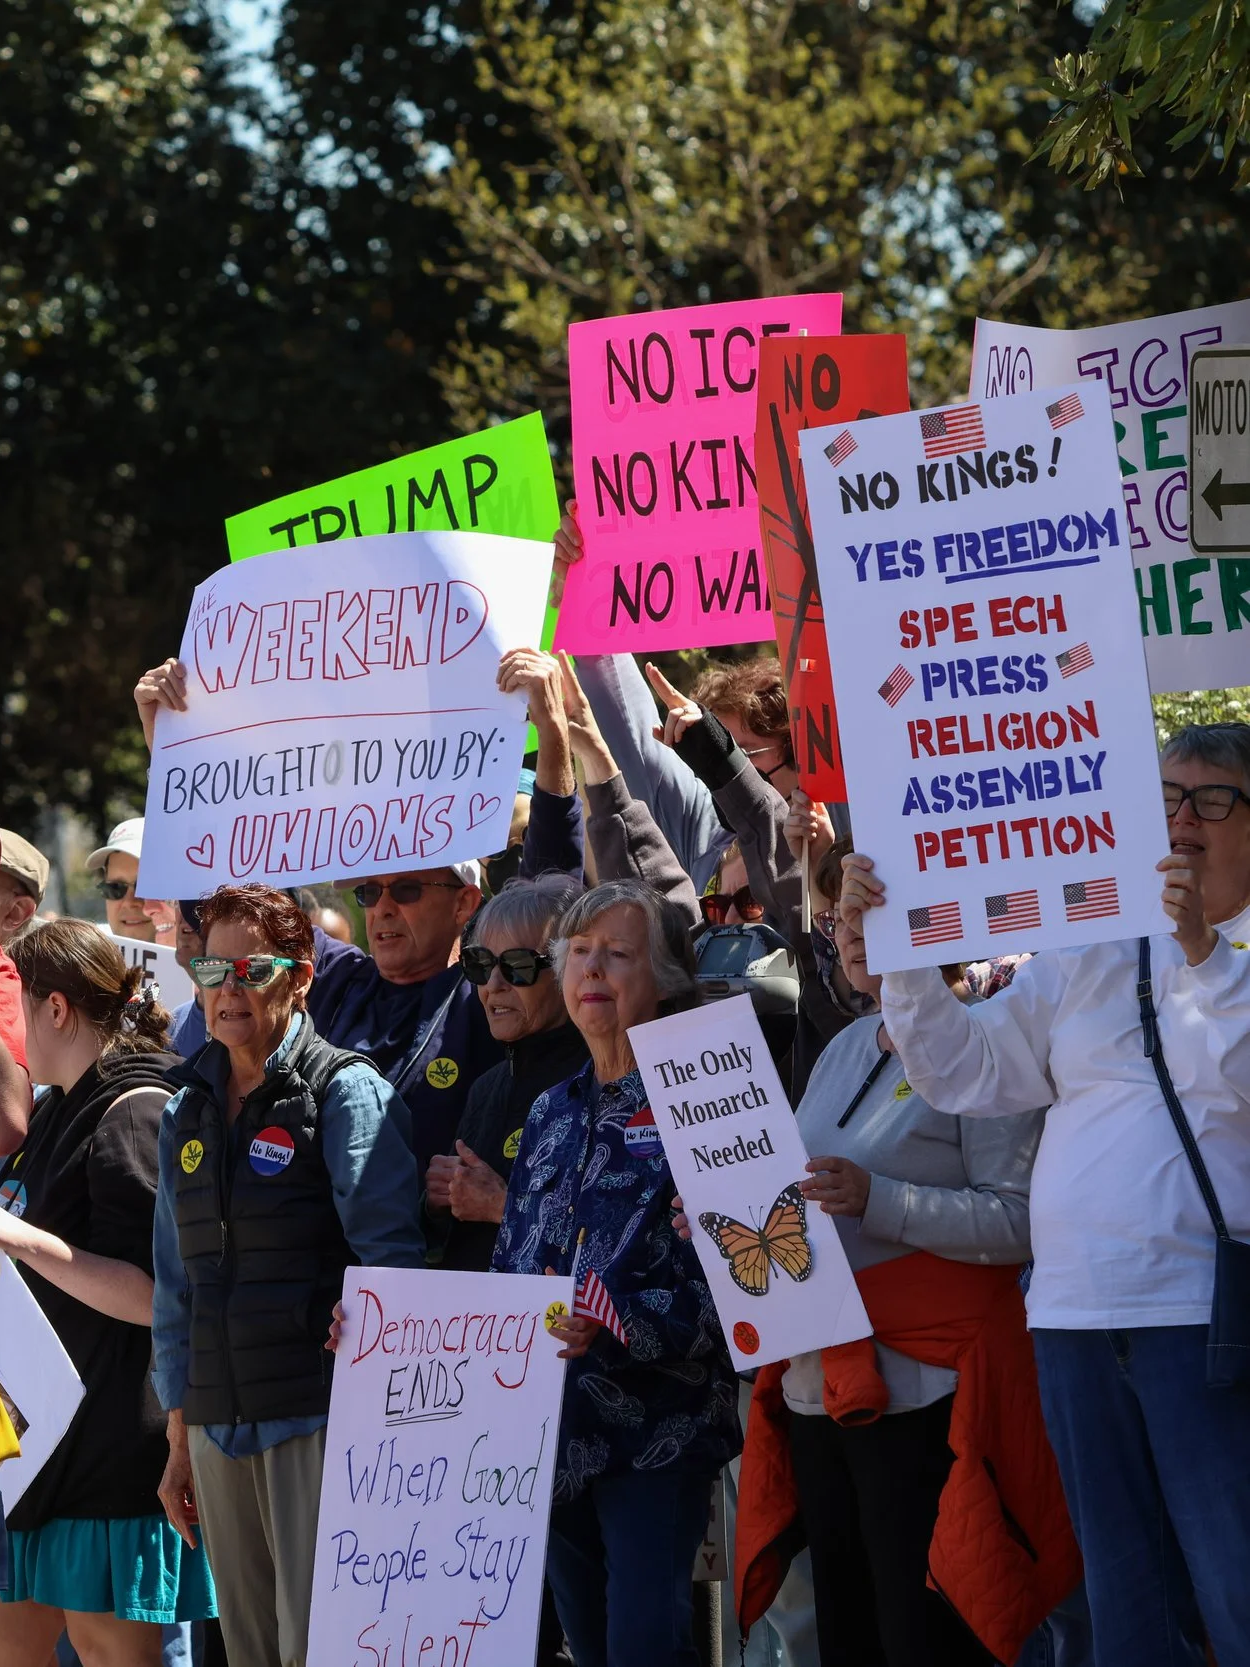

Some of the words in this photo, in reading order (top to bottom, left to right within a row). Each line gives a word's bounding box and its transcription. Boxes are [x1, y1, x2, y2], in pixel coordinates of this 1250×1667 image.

[606, 332, 675, 405] NO
[690, 323, 790, 398] IC
[783, 352, 841, 414] NO
[1196, 379, 1250, 435] MOTO
[592, 451, 658, 517] NO
[670, 435, 759, 513] KIN
[839, 470, 899, 515] NO
[917, 437, 1062, 504] KINGS!
[845, 538, 925, 582] YES
[935, 508, 1121, 577] FREEDOM
[191, 584, 217, 631] THE
[609, 561, 674, 627] NO
[695, 549, 772, 614] WA
[1134, 558, 1250, 636] HER
[194, 580, 488, 694] WEEKEND
[920, 652, 1048, 702] PRESS
[351, 737, 383, 786] TO
[394, 737, 448, 788] YOU
[453, 727, 506, 782] BY:
[906, 700, 1100, 760] RELIGION
[901, 750, 1107, 816] ASSEMBLY
[229, 793, 456, 878] UNIONS
[914, 810, 1116, 872] PETITION
[654, 1058, 698, 1089] The
[700, 1041, 753, 1077] Only
[667, 1081, 769, 1130] Monarch
[251, 1142, 262, 1155] No
[265, 1143, 290, 1163] Kings!
[690, 1128, 776, 1173] Needed
[350, 1287, 540, 1389] Democracy
[385, 1356, 471, 1419] ENDS
[345, 1436, 448, 1509] When
[462, 1415, 550, 1513] Good
[332, 1521, 427, 1614] People
[440, 1516, 530, 1620] Stay
[354, 1595, 491, 1667] Silent
